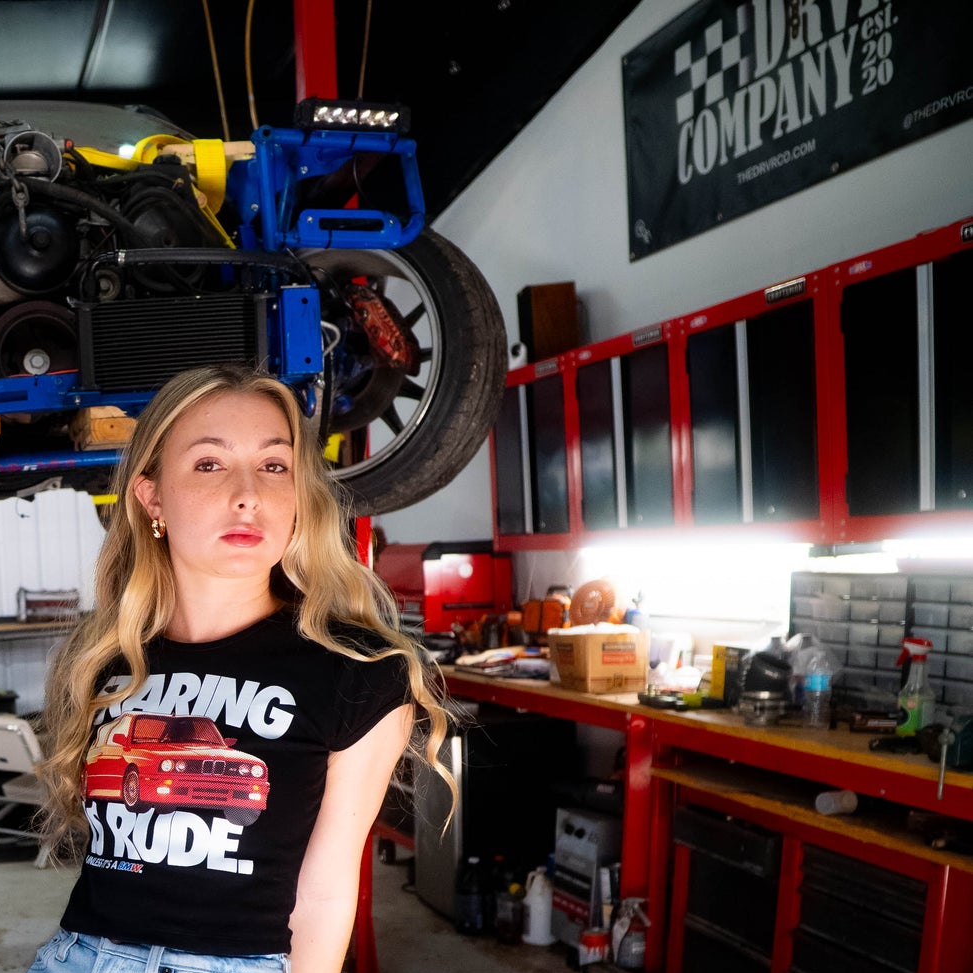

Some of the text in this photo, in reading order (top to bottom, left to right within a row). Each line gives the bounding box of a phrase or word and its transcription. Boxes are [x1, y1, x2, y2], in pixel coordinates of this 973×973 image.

[861, 3, 899, 40] est.
[861, 32, 893, 70] 20
[862, 59, 894, 96] 20
[677, 24, 858, 185] COMPANY
[737, 138, 816, 184] THEDRVRCO.COM
[106, 802, 254, 875] RUDE.
[111, 860, 118, 870] A
